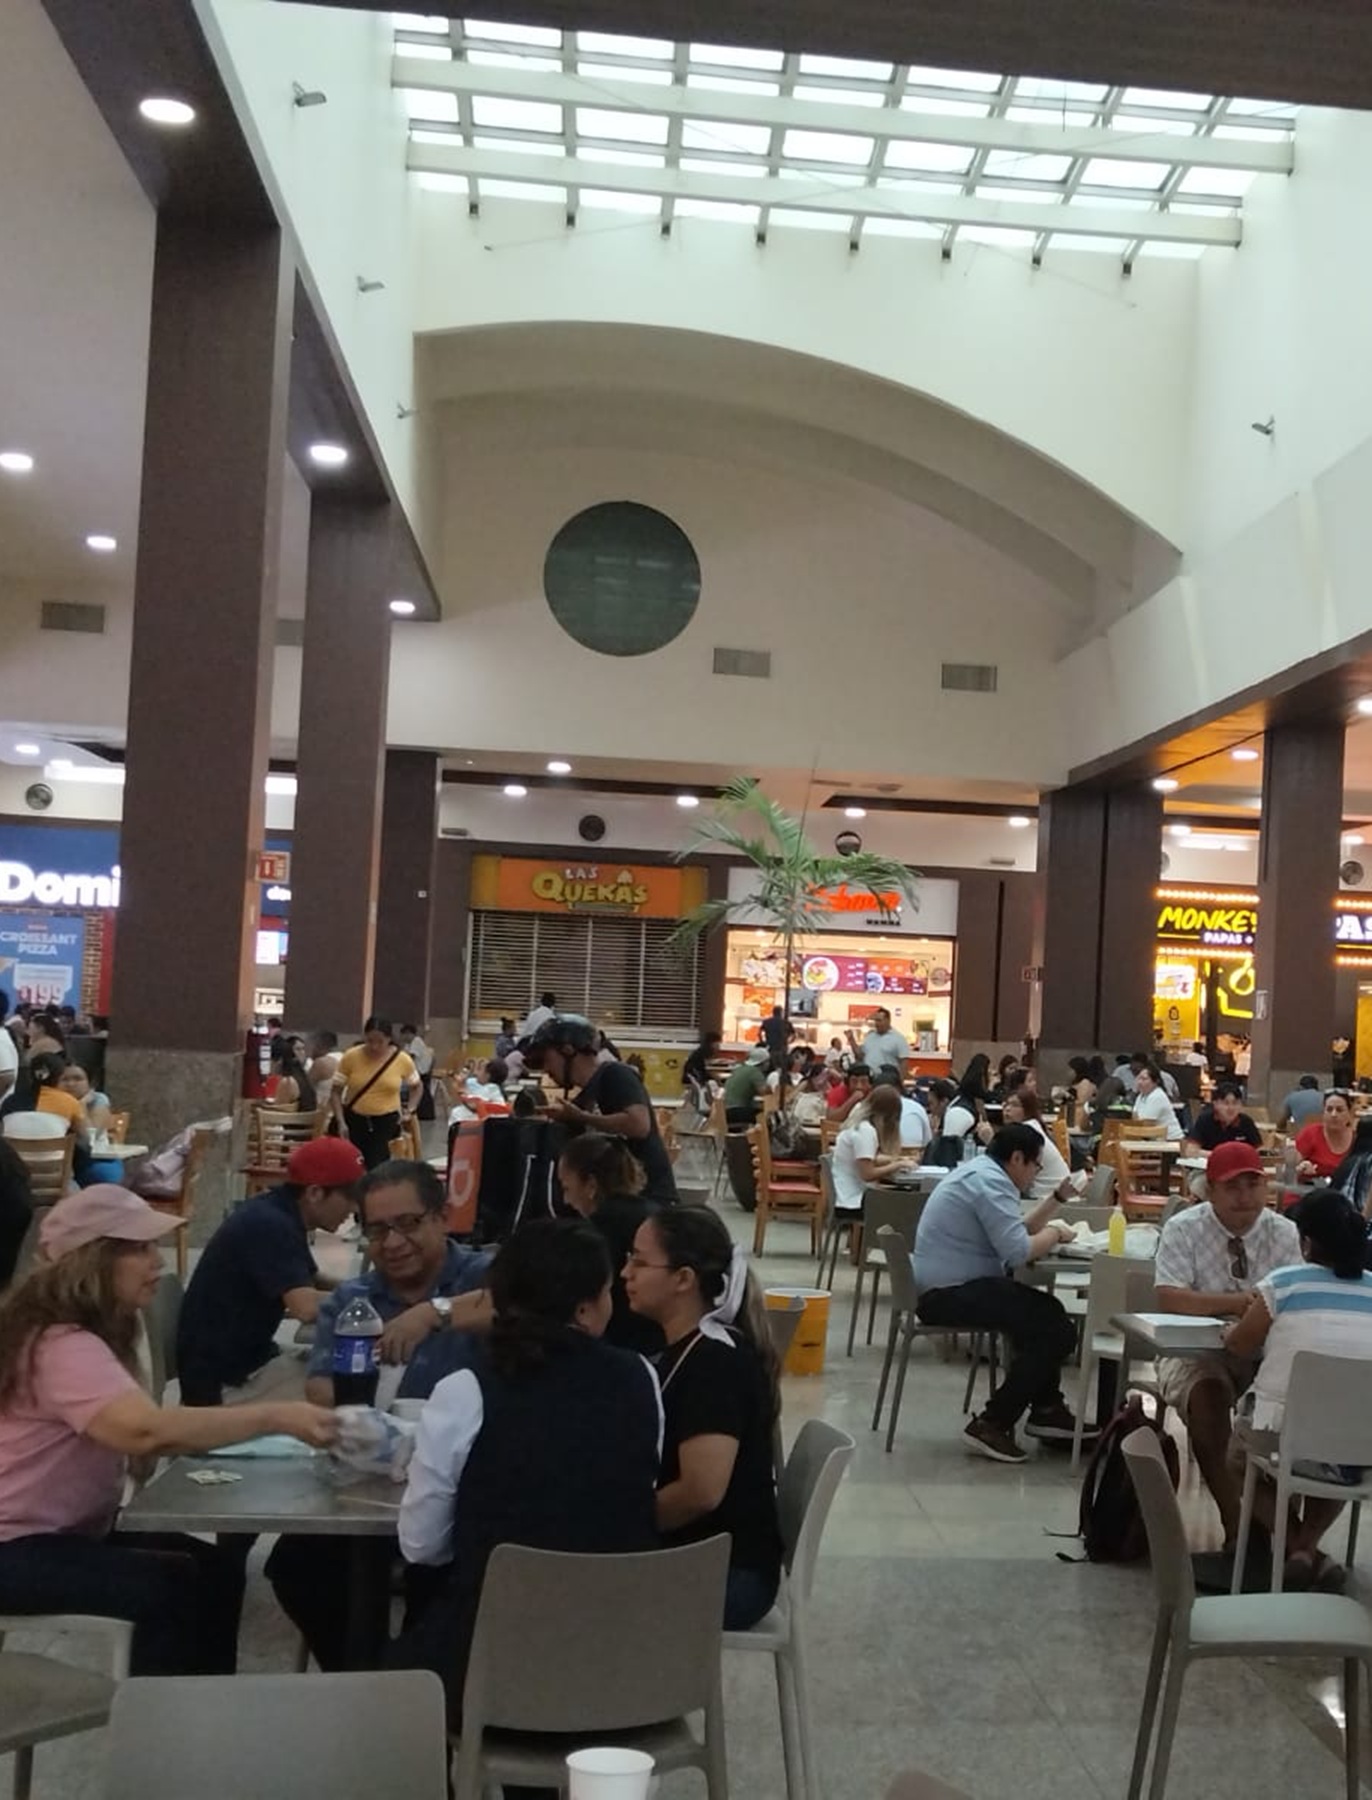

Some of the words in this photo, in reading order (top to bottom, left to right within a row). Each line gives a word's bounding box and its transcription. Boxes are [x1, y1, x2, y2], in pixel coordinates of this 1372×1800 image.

[565, 866, 598, 880] LAS
[0, 860, 120, 907] Domi
[0, 931, 78, 946] CROISSANT
[1203, 931, 1243, 945] PAPAS
[17, 943, 59, 956] PIZZA
